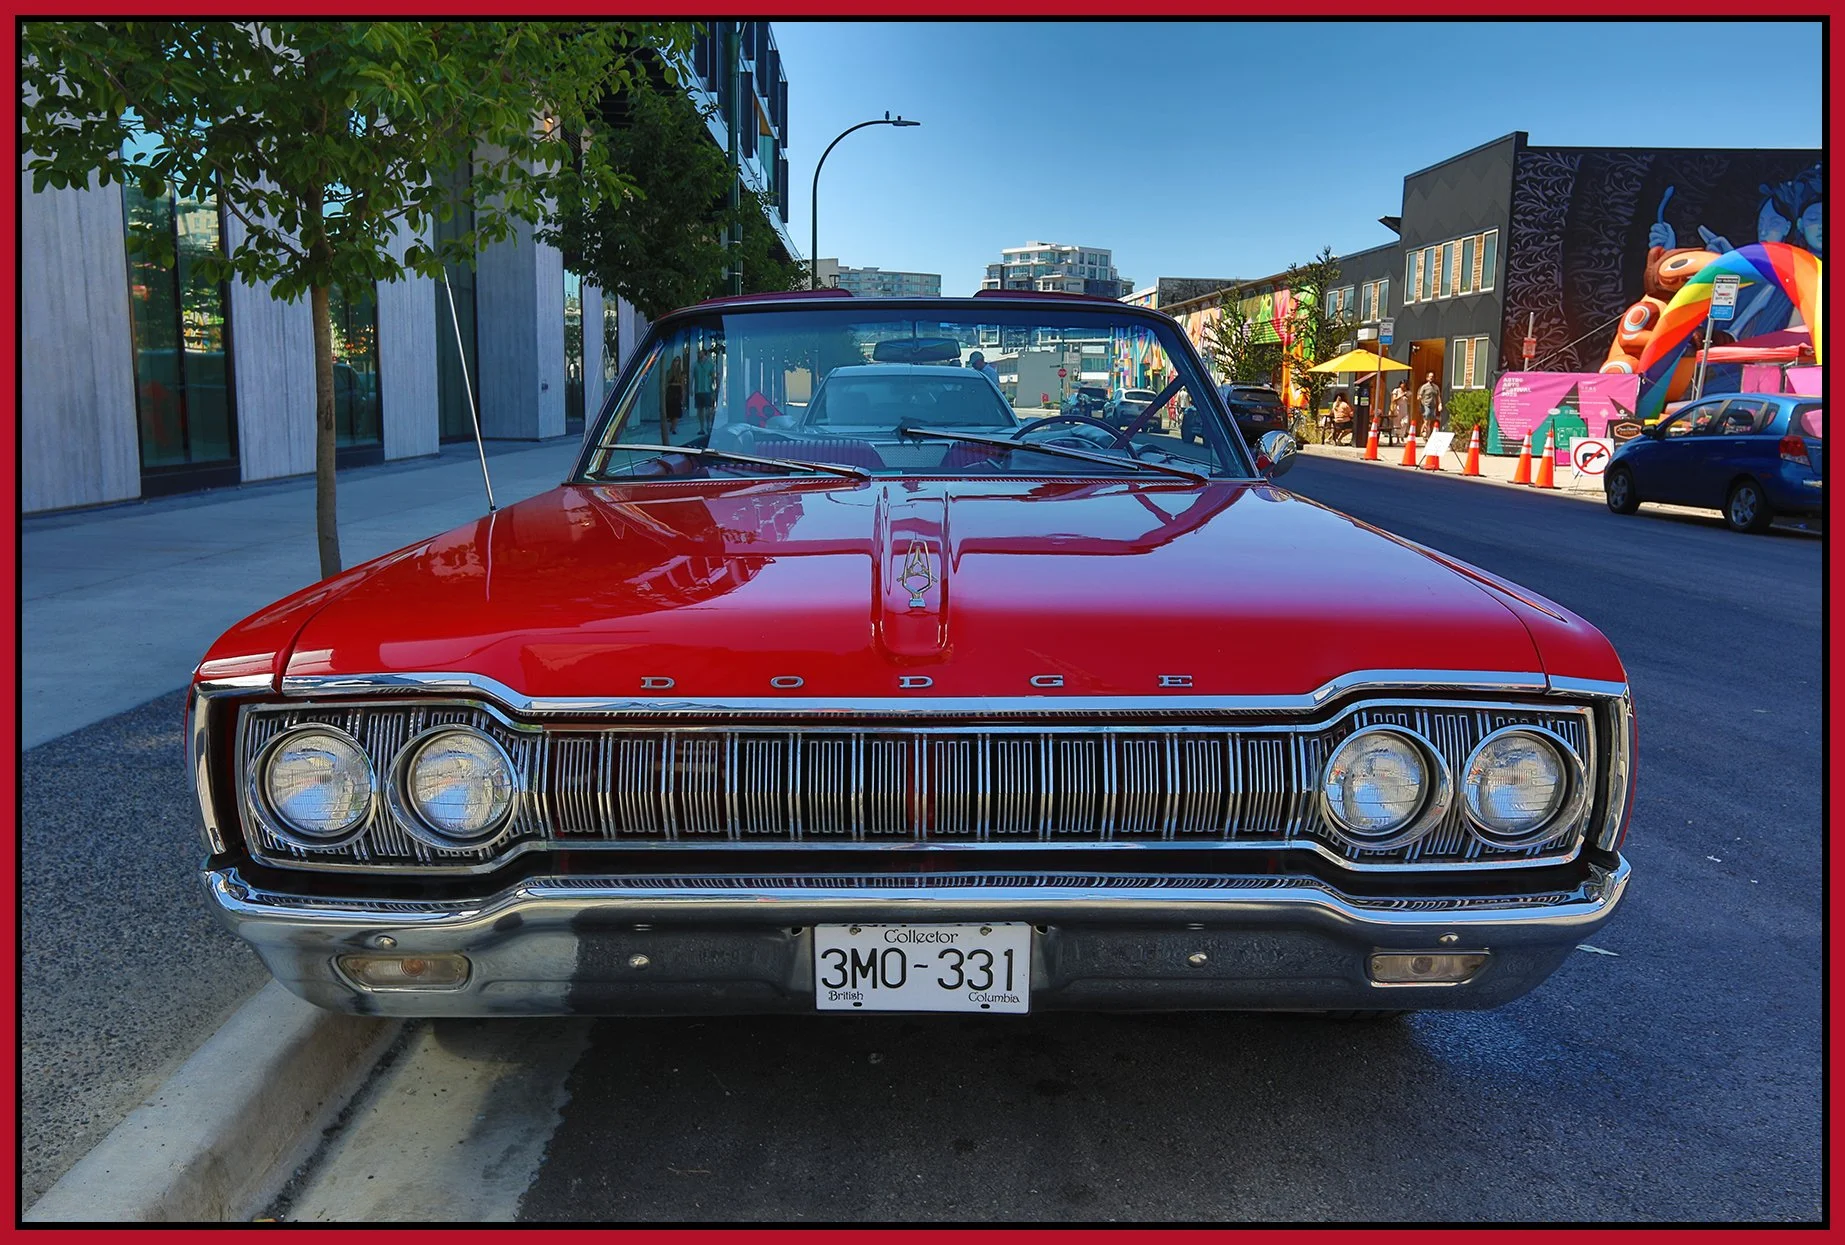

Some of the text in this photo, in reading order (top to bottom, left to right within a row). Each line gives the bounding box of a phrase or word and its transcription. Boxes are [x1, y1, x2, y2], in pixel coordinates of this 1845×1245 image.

[640, 674, 1193, 689] DODGE
[884, 929, 958, 944] Collector
[828, 990, 1020, 1003] British Columbia
